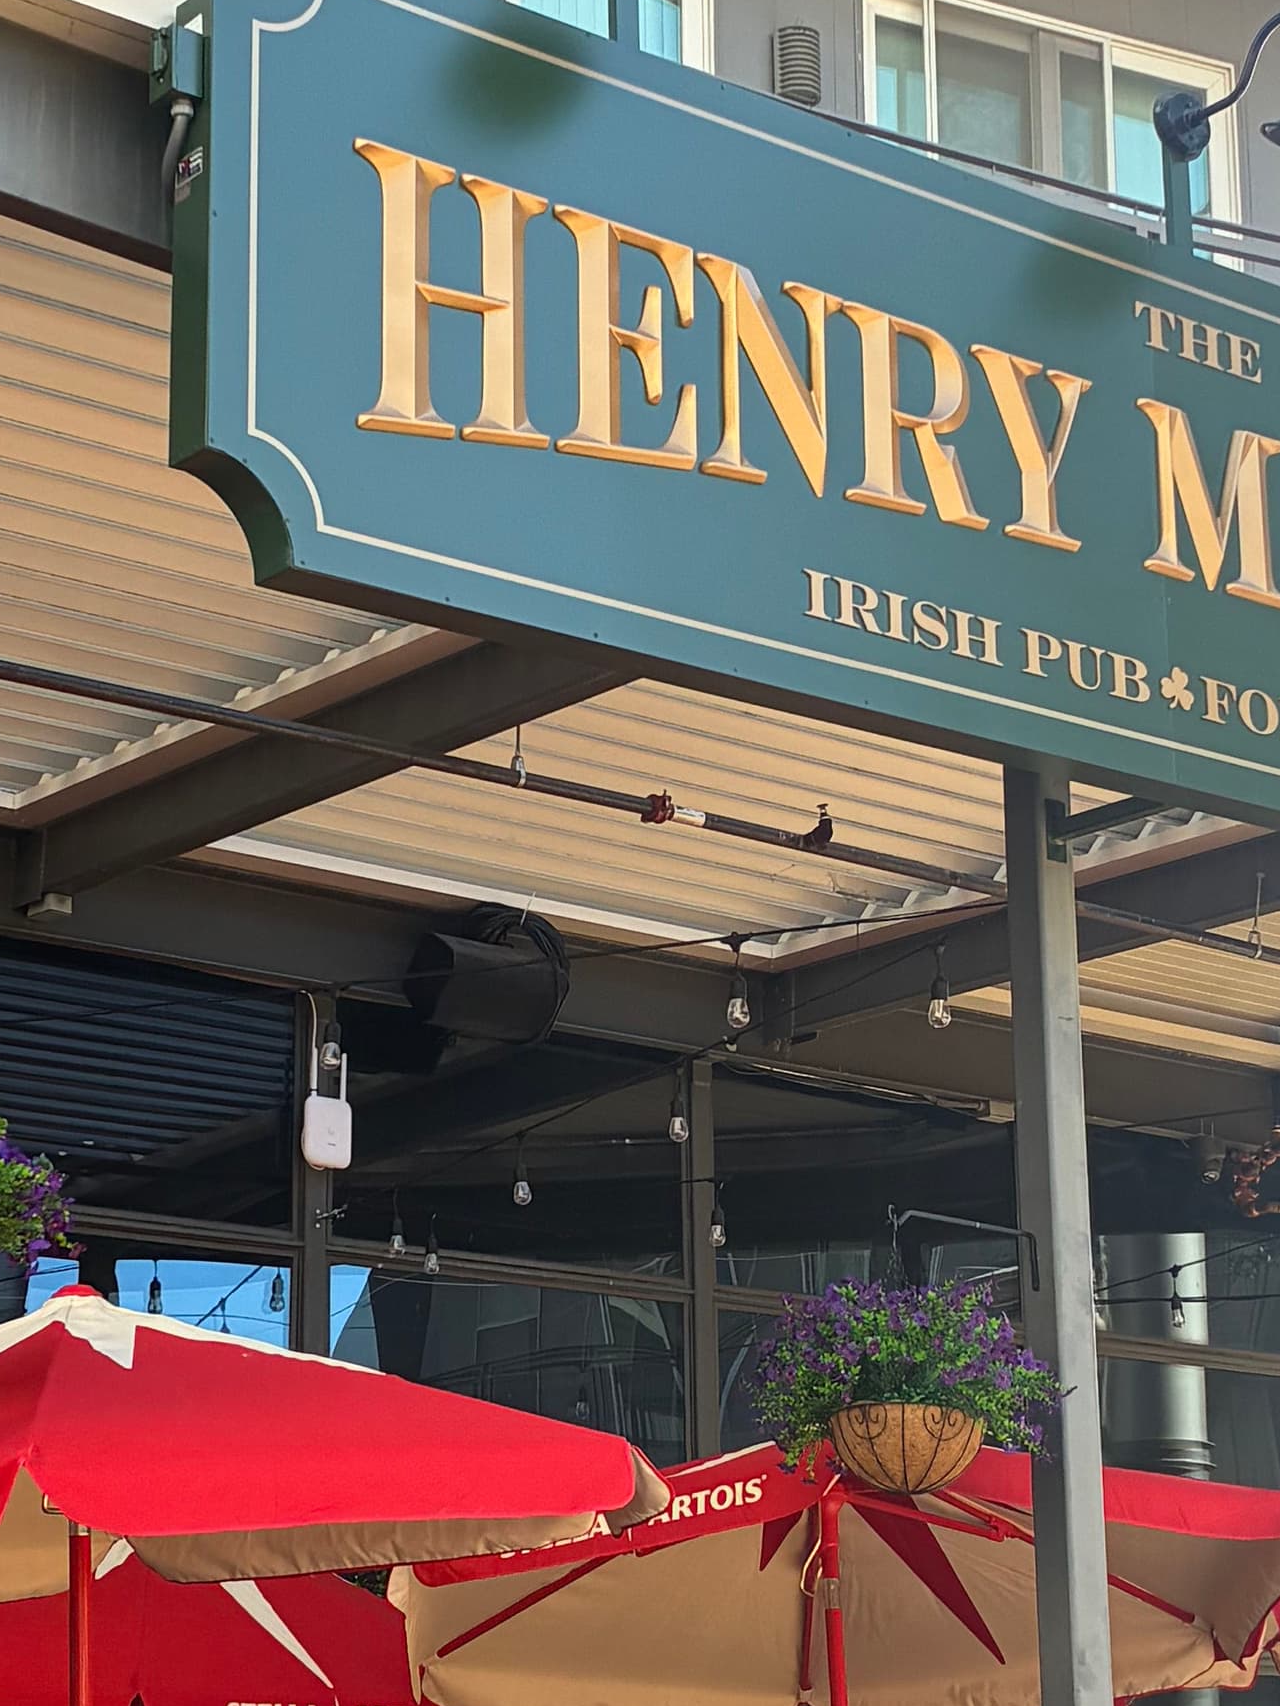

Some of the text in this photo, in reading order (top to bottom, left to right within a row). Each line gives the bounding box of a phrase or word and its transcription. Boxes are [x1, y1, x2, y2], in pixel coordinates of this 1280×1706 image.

[353, 137, 1093, 552] HENRY
[1135, 300, 1263, 385] THE
[802, 568, 1004, 668] IRISH
[1021, 627, 1151, 704] PUB
